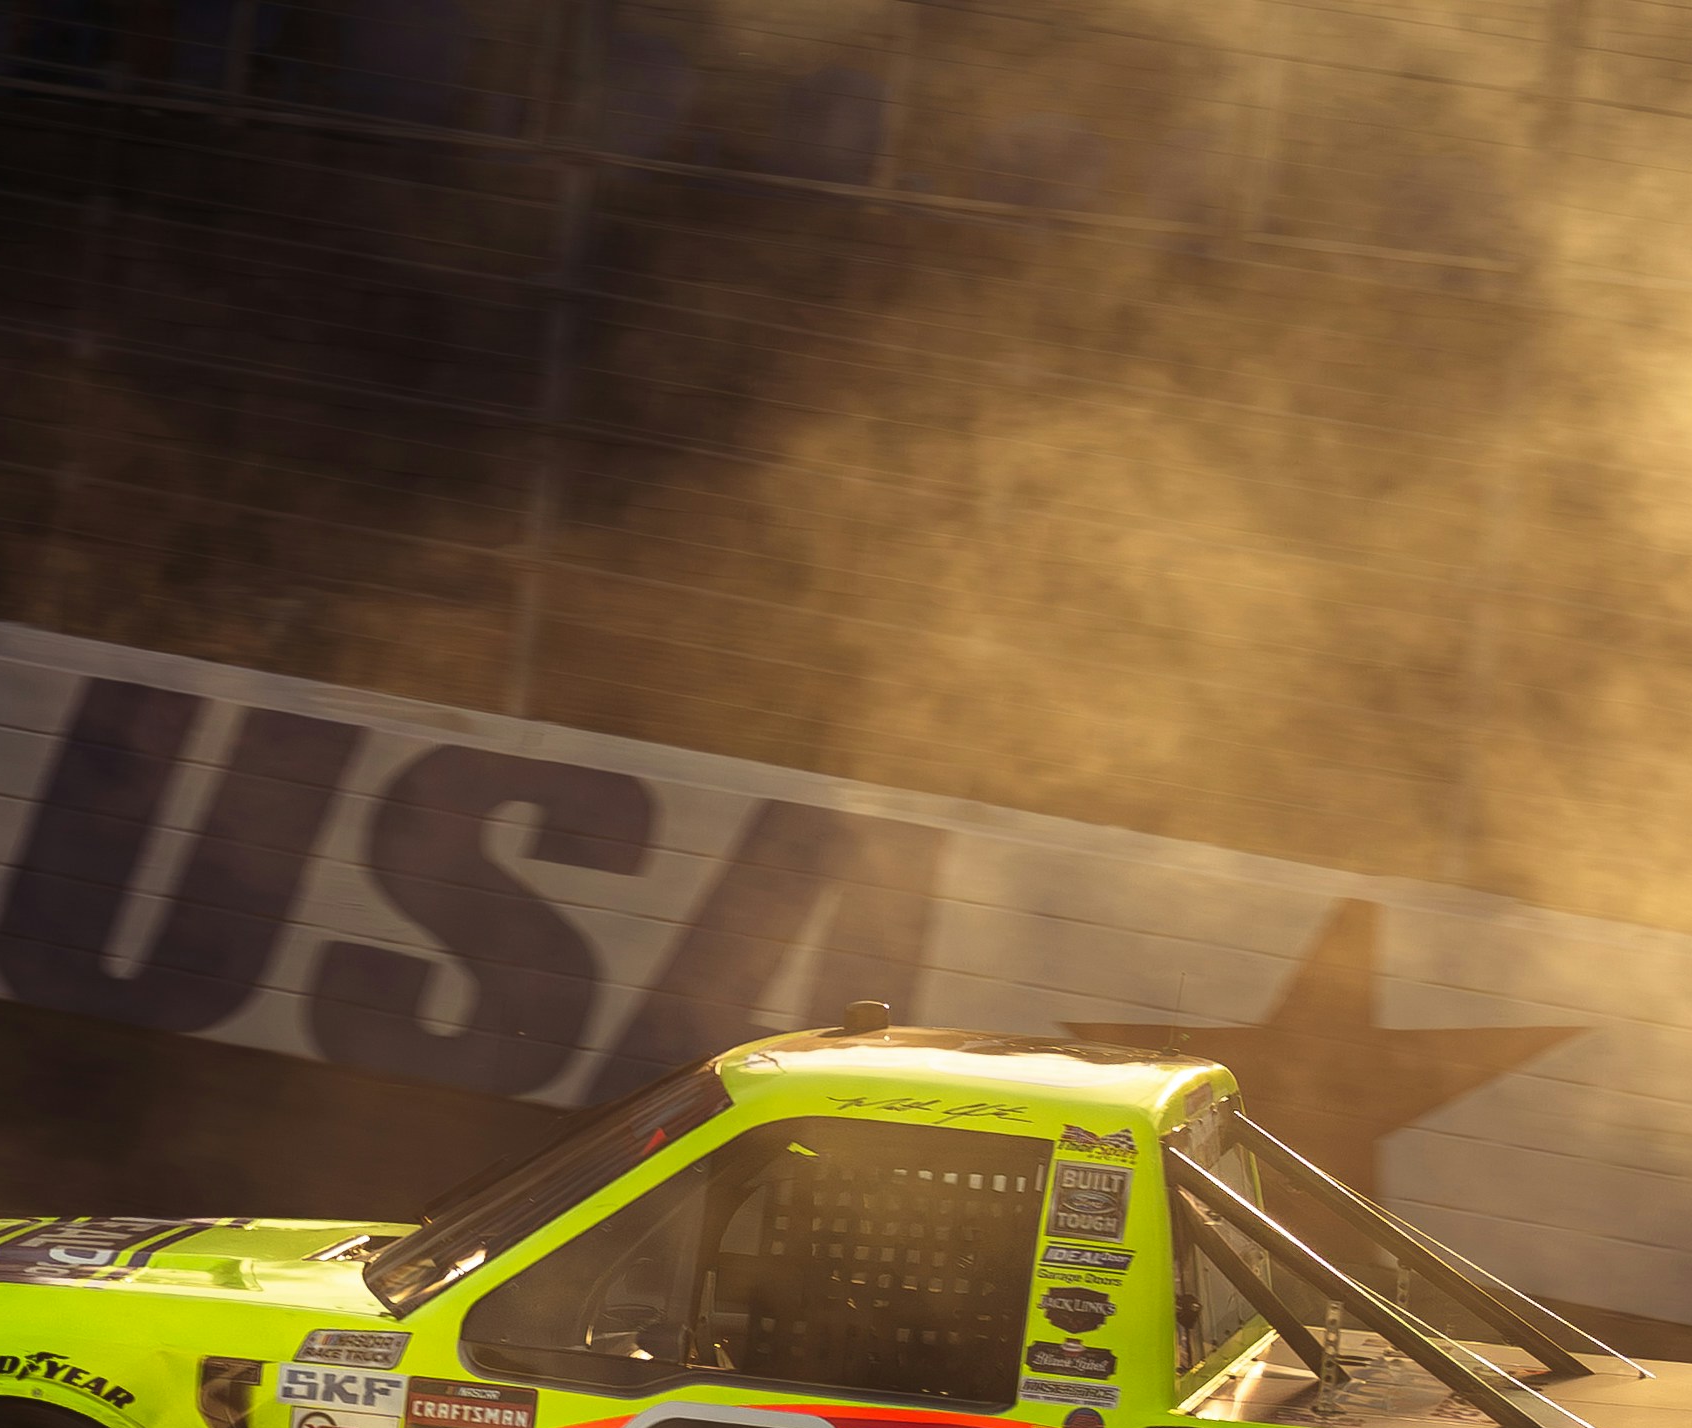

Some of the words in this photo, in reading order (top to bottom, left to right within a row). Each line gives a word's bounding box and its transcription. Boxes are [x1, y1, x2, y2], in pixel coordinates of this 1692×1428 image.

[1061, 1169, 1124, 1193] BUILT
[1056, 1213, 1118, 1234] TOUGH
[281, 1369, 402, 1407] SKF
[411, 1400, 529, 1428] CRAFTSMAN
